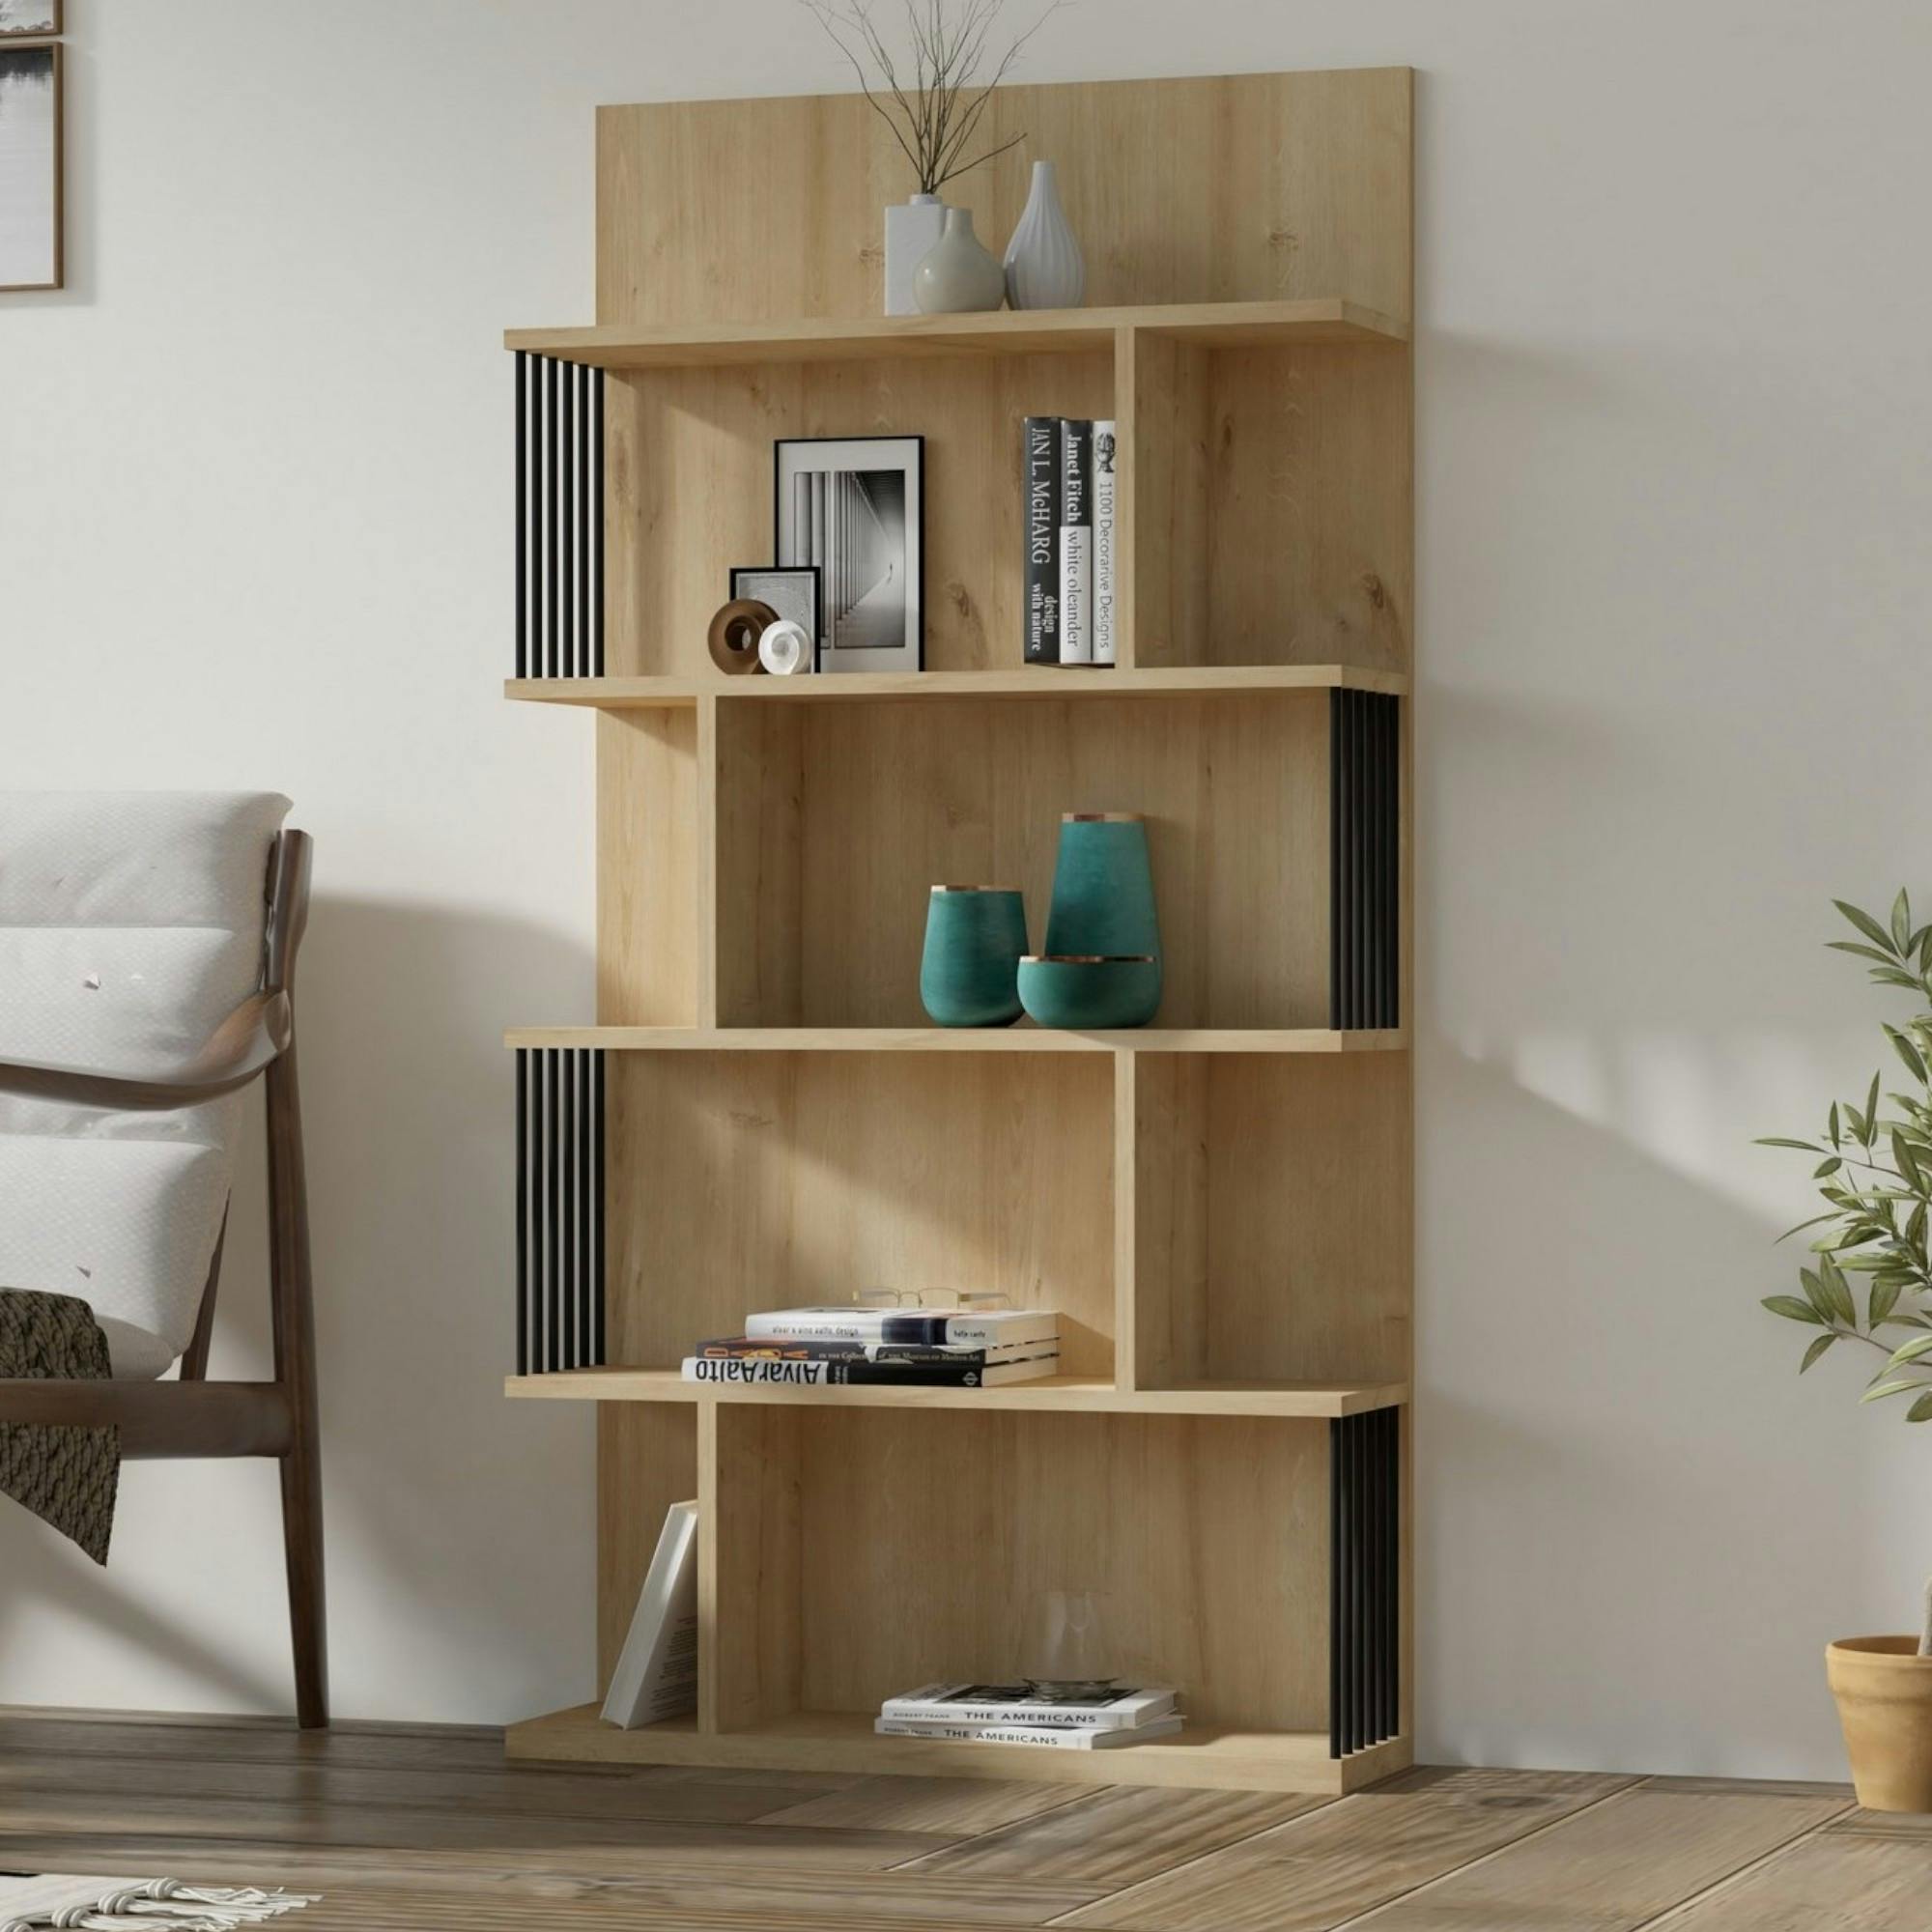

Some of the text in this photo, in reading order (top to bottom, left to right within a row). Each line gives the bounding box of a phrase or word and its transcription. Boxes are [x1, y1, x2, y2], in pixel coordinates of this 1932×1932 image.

[1032, 460, 1051, 476] L.
[1066, 434, 1082, 523] Janet Fitch
[1099, 482, 1112, 515] 1100
[1032, 480, 1051, 564] McHARG
[1067, 530, 1082, 647] white oleander
[1031, 583, 1043, 652] with nature
[1042, 595, 1058, 634] design
[1097, 596, 1112, 649] Designs
[696, 1360, 821, 1384] AlvarAalto
[964, 1711, 1096, 1724] THE AMERICANS
[945, 1729, 1059, 1746] THE AMERICANS
